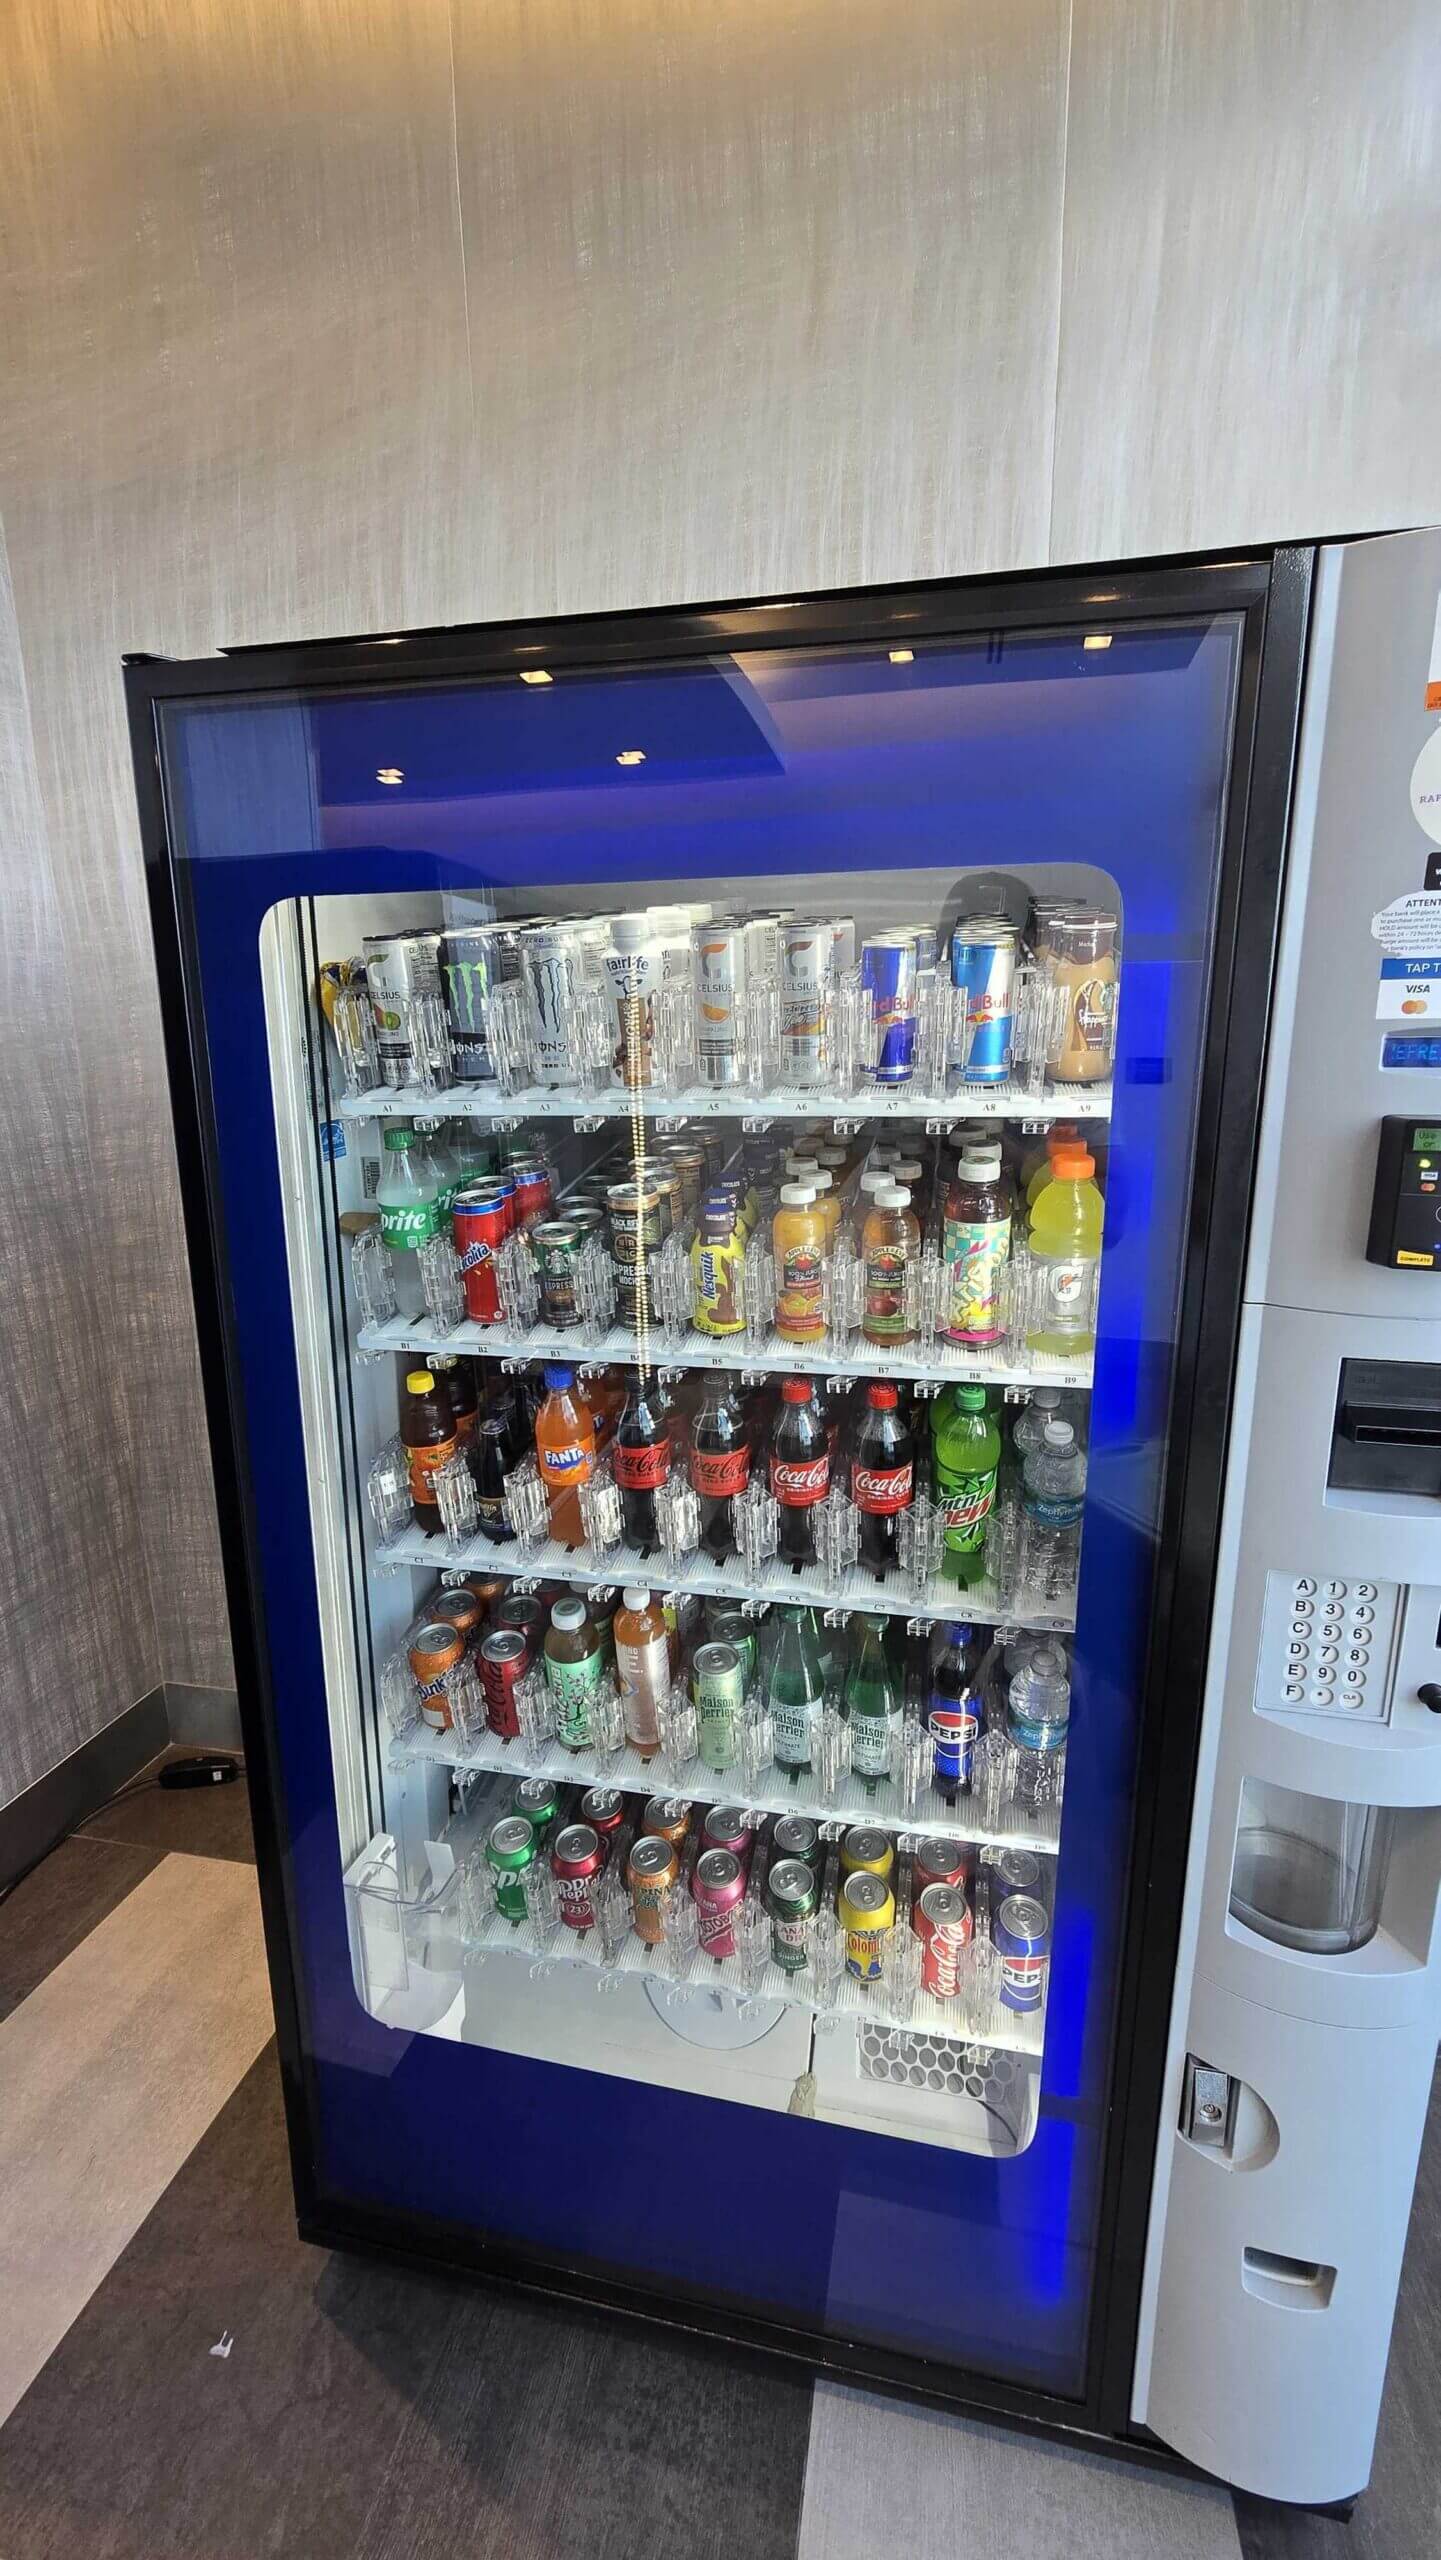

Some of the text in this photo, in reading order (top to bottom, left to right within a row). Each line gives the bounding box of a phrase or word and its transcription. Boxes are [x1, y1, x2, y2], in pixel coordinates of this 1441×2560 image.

[1405, 963, 1430, 973] TAP
[1405, 984, 1430, 993] VISA
[381, 1210, 426, 1231] prite
[700, 1251, 718, 1300] Nesquik
[878, 1366, 889, 1374] B7
[544, 1448, 584, 1464] FANTA
[1296, 1579, 1368, 1596] A 1 2
[1295, 1601, 1365, 1618] B 3 4
[1293, 1622, 1362, 1639] C 5 6
[1290, 1643, 1360, 1660] D 7 8
[1288, 1664, 1357, 1681] E 9 0
[1286, 1685, 1296, 1695] F
[931, 1721, 977, 1740] PEPSI
